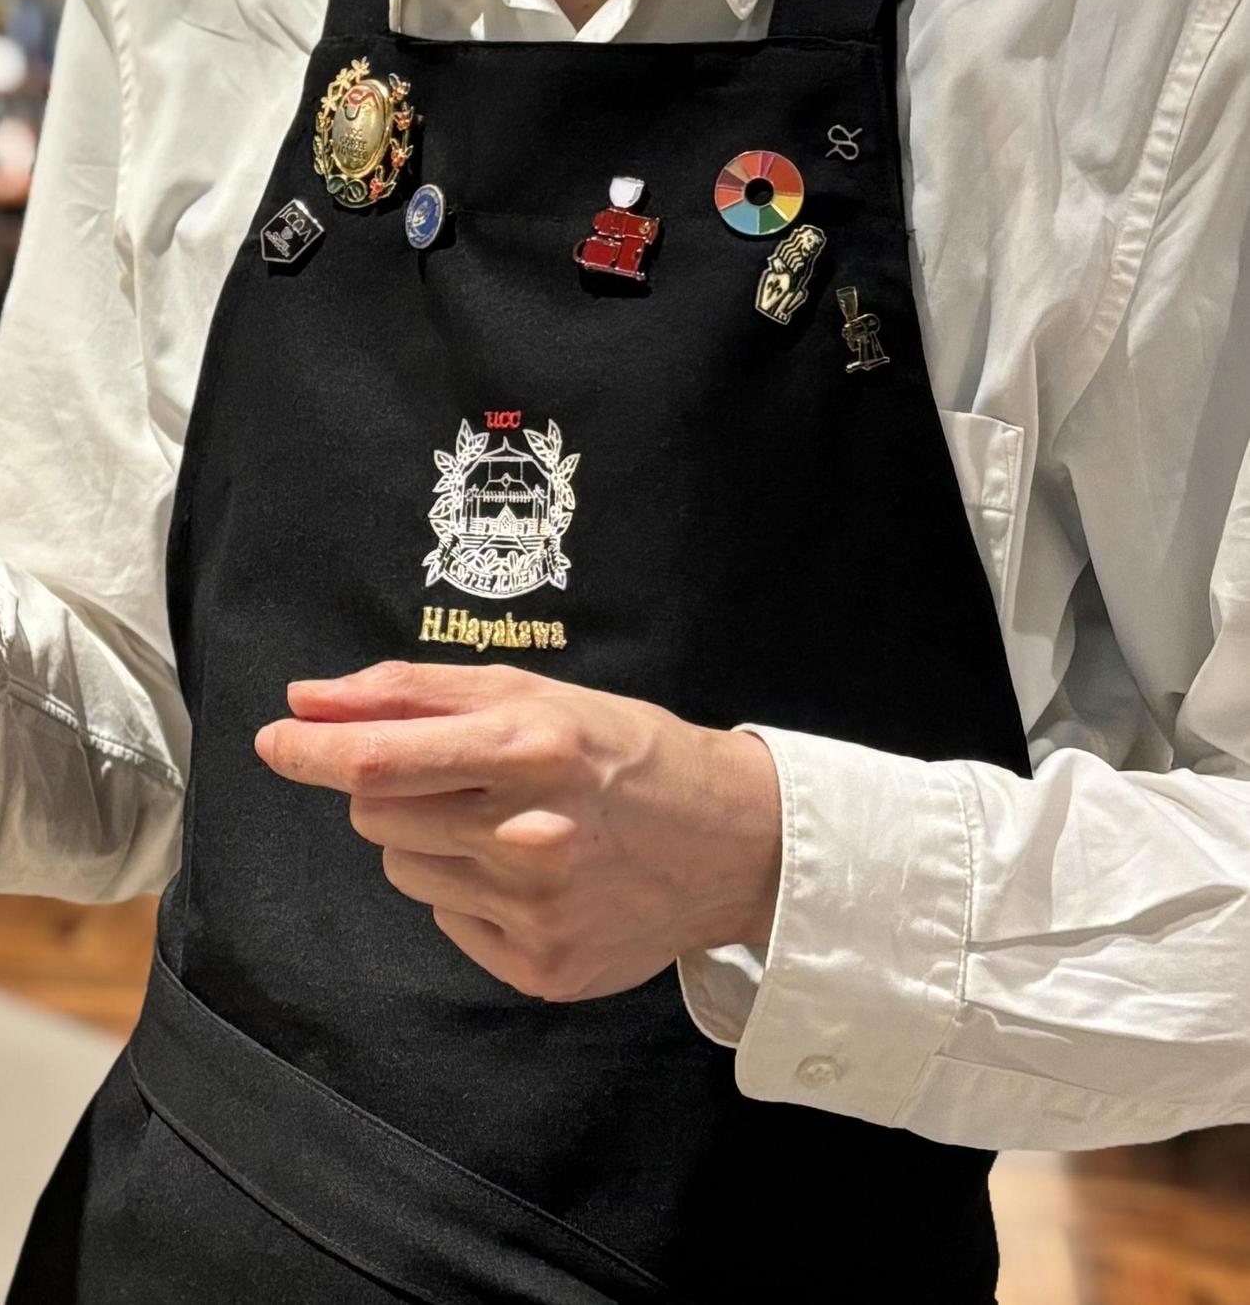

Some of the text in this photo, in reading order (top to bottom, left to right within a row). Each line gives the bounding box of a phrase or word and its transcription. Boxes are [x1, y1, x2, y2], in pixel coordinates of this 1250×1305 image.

[484, 410, 521, 428] UCC
[449, 560, 544, 592] COFFEE ACADEMY
[418, 606, 567, 652] H.Hayakawa
